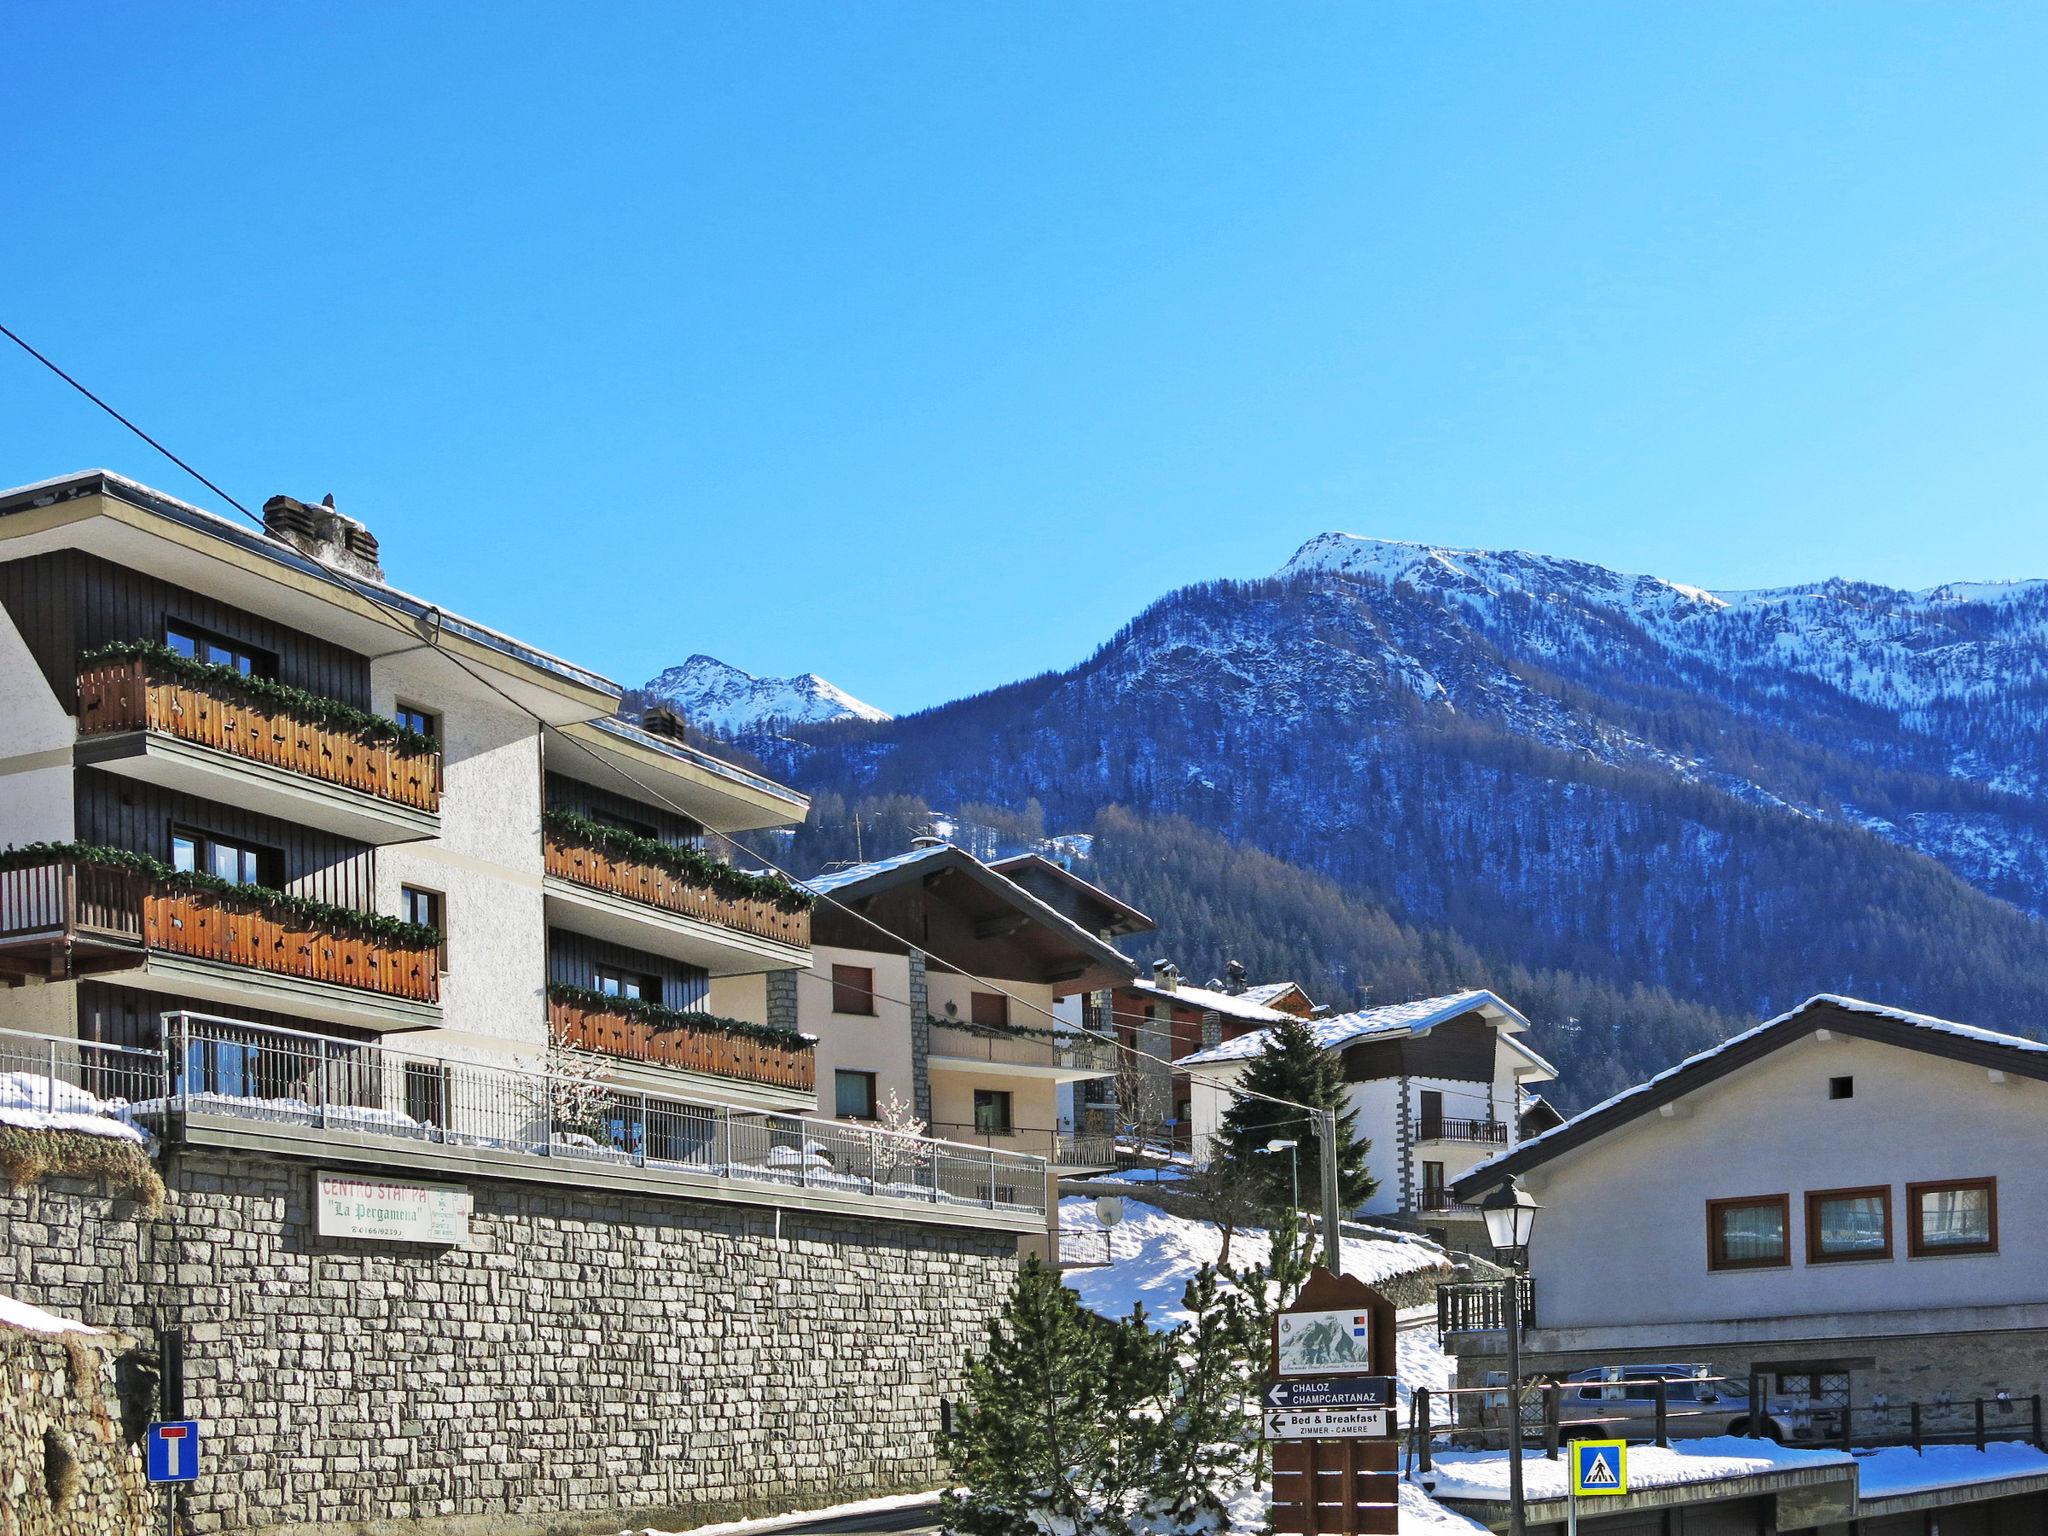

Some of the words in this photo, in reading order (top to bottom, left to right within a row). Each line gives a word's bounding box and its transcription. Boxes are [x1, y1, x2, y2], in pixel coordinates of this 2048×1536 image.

[323, 1178, 372, 1198] CENTRO
[378, 1183, 428, 1203] STAMPA
[1292, 1383, 1330, 1392] CHALOZ
[1293, 1393, 1376, 1404] CHAMPCARTANAZ
[1291, 1415, 1311, 1425] Bed
[1314, 1415, 1322, 1424] &
[1325, 1414, 1378, 1424] Breakfast
[1300, 1427, 1329, 1435] ZIMMER
[1335, 1425, 1368, 1434] CAMERE
